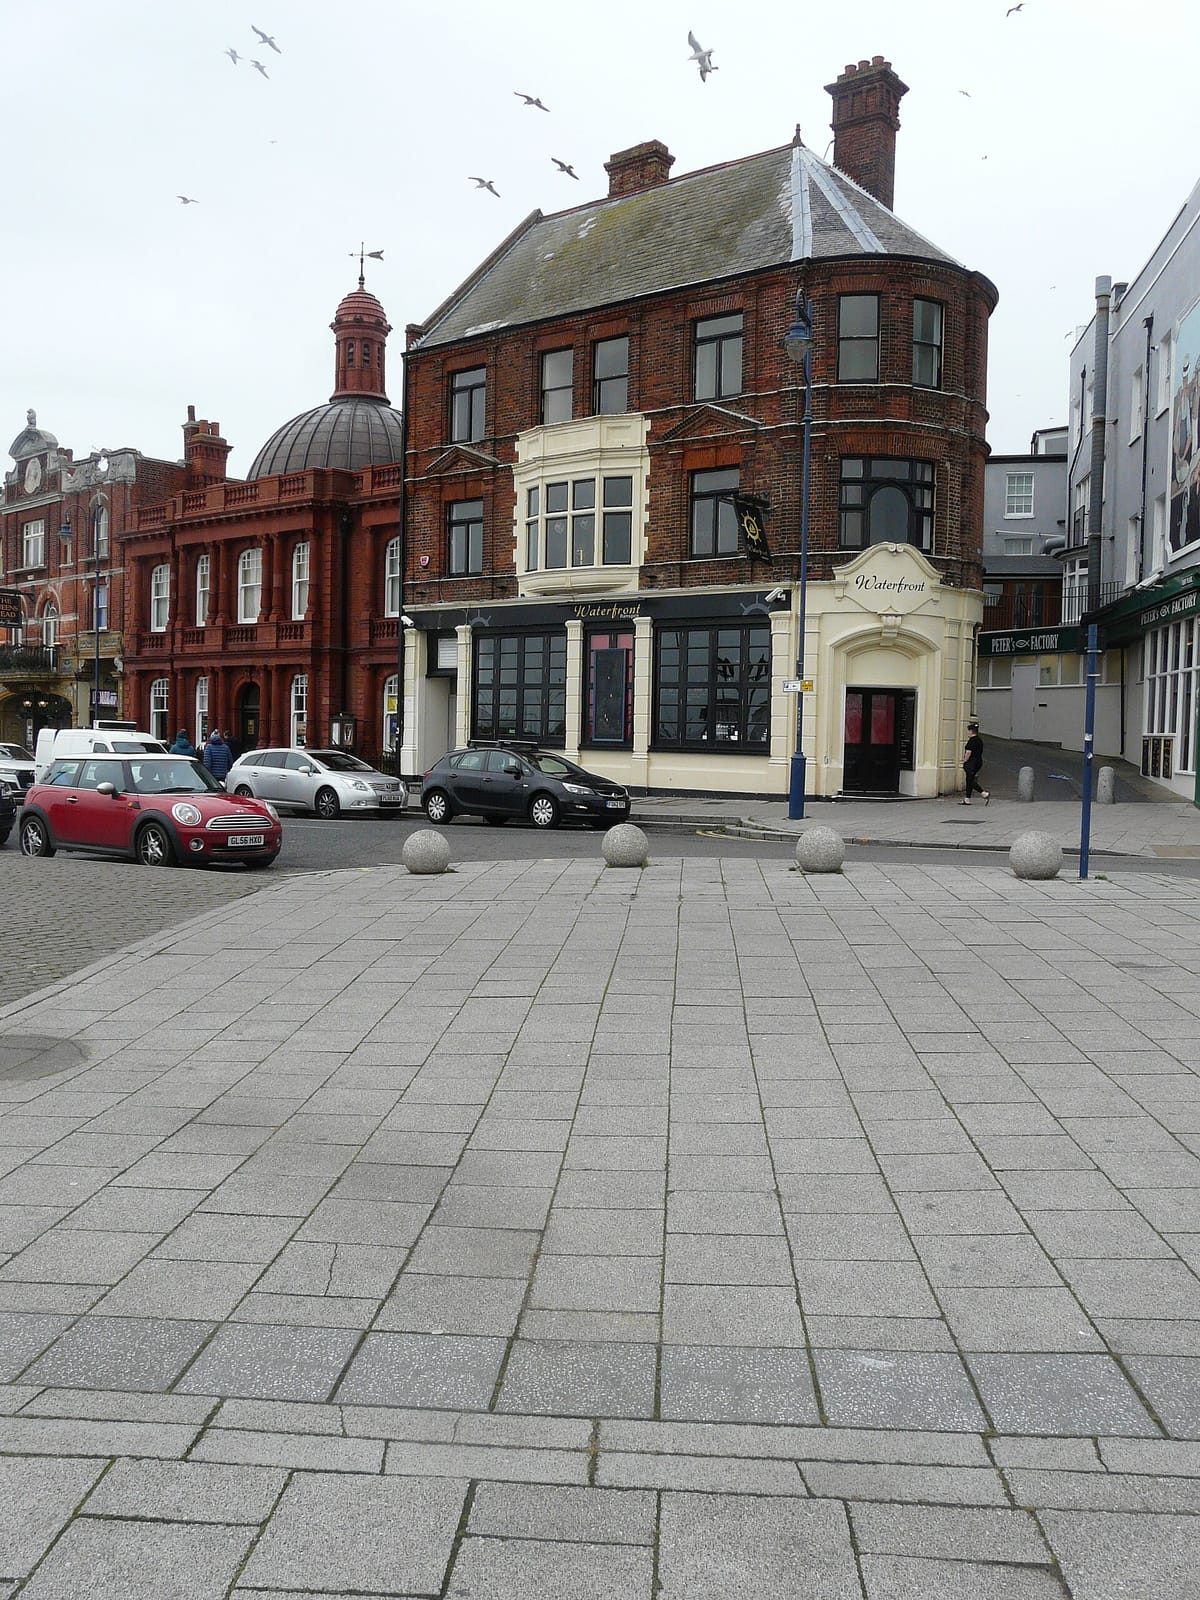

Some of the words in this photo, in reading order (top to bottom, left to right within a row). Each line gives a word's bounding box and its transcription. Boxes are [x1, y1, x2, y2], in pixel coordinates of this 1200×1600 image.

[855, 574, 925, 593] Waterfront
[574, 603, 640, 619] Waterfront
[1171, 592, 1197, 615] FACTORY
[1030, 634, 1059, 650] FACTORY
